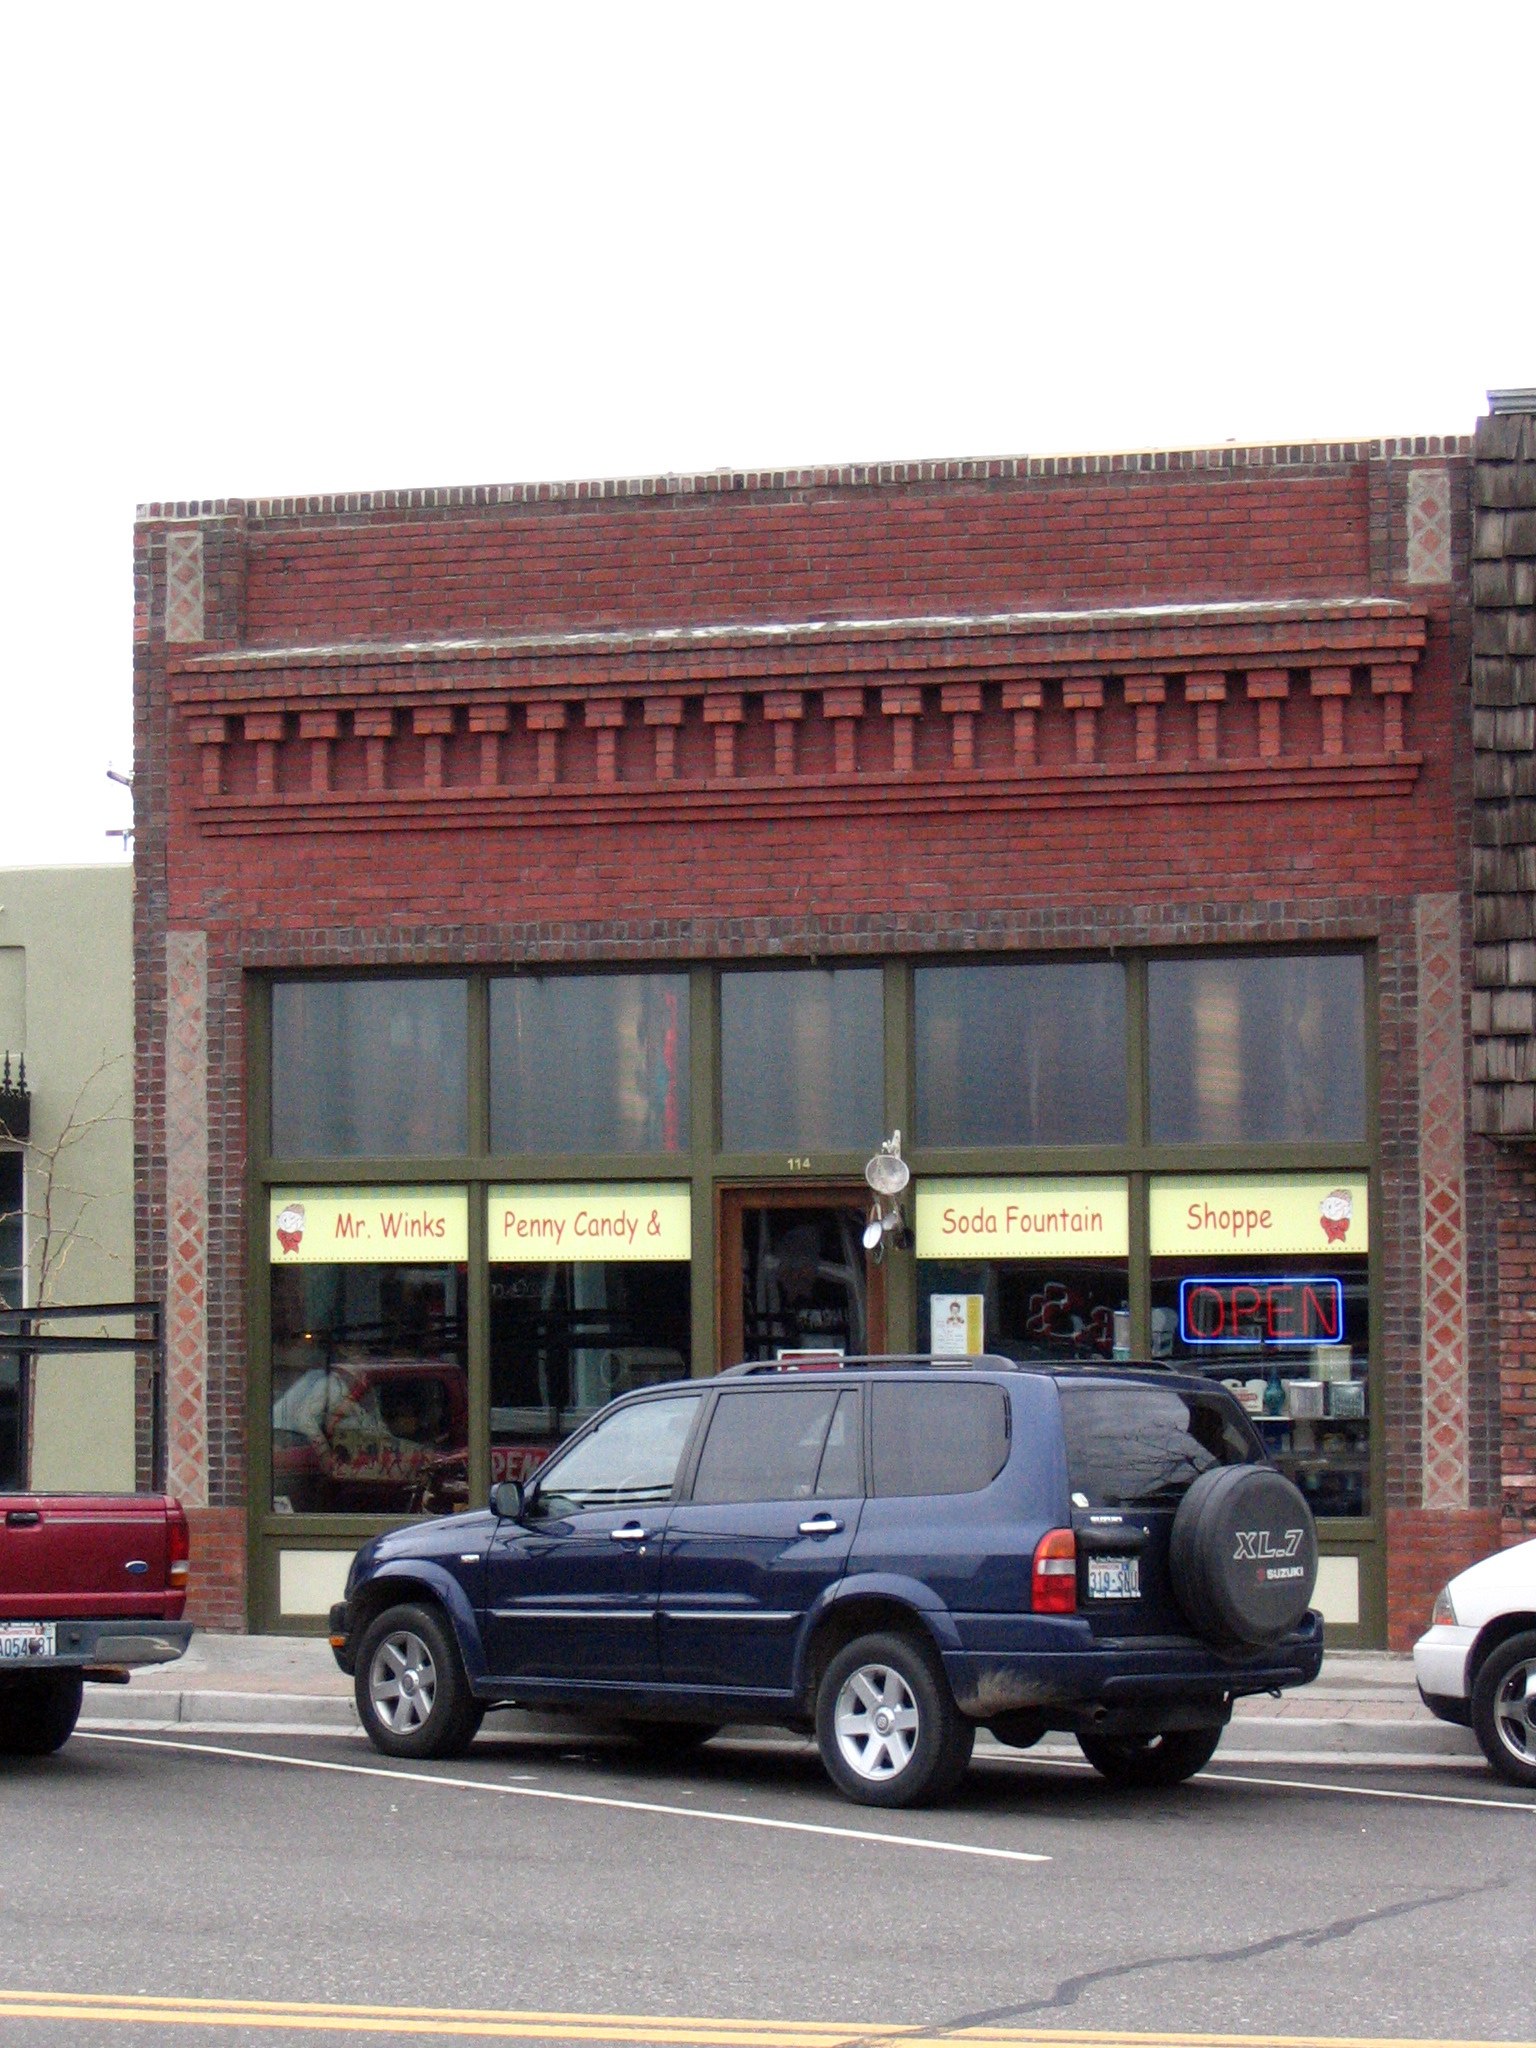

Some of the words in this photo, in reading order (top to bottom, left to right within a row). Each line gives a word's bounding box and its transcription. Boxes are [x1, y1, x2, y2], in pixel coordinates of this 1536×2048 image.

[787, 1157, 811, 1171] 114
[335, 1212, 371, 1239] Mr.
[380, 1210, 446, 1239] Winks
[504, 1211, 567, 1246] Penny
[574, 1209, 639, 1245] Candy
[647, 1209, 662, 1237] &
[942, 1206, 998, 1234] Soda
[1006, 1205, 1103, 1234] Fountain
[1187, 1201, 1273, 1238] Shoppe
[1187, 1285, 1338, 1337] OPEN
[1266, 1566, 1304, 1580] SUZUKI
